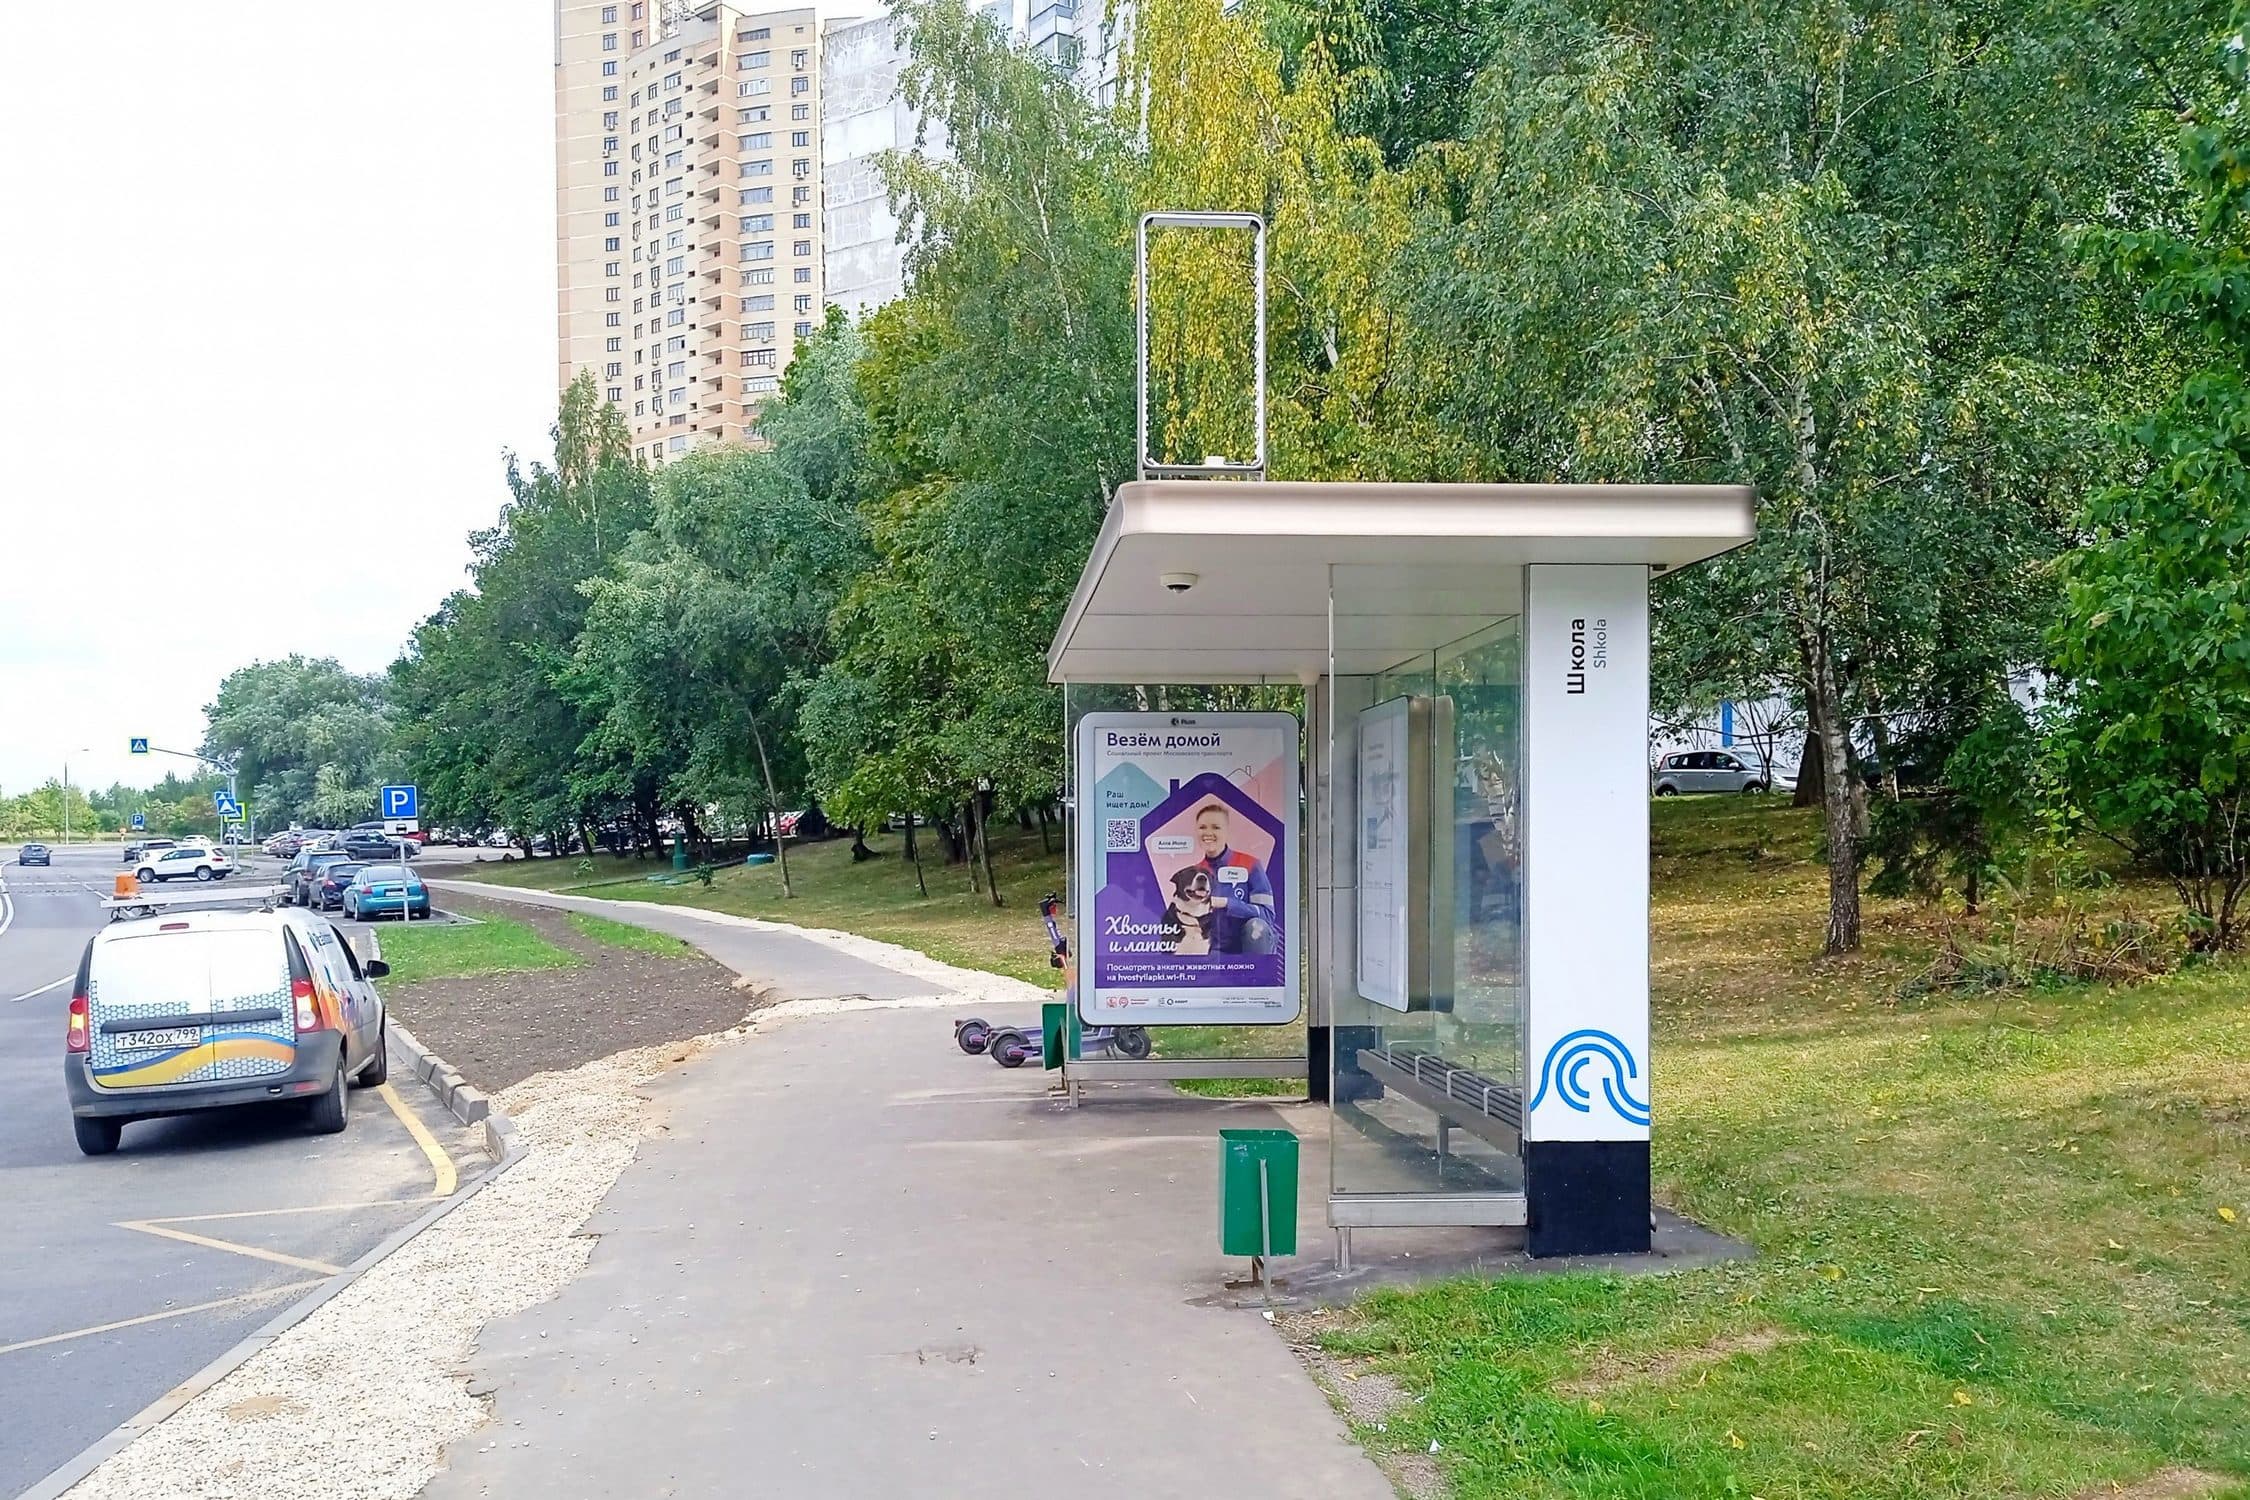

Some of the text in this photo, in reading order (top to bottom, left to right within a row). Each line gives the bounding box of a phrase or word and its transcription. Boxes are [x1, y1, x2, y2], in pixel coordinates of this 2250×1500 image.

[1593, 619, 1607, 669] Shkola
[1567, 619, 1585, 694] Школа
[1107, 732, 1221, 749] Везём домой
[391, 790, 408, 814] P
[1106, 790, 1124, 798] Раш
[1130, 800, 1150, 809] дом!
[1105, 914, 1181, 935] Хвосты
[1109, 941, 1177, 953] и лапки
[1106, 963, 1155, 972] Посмотреть
